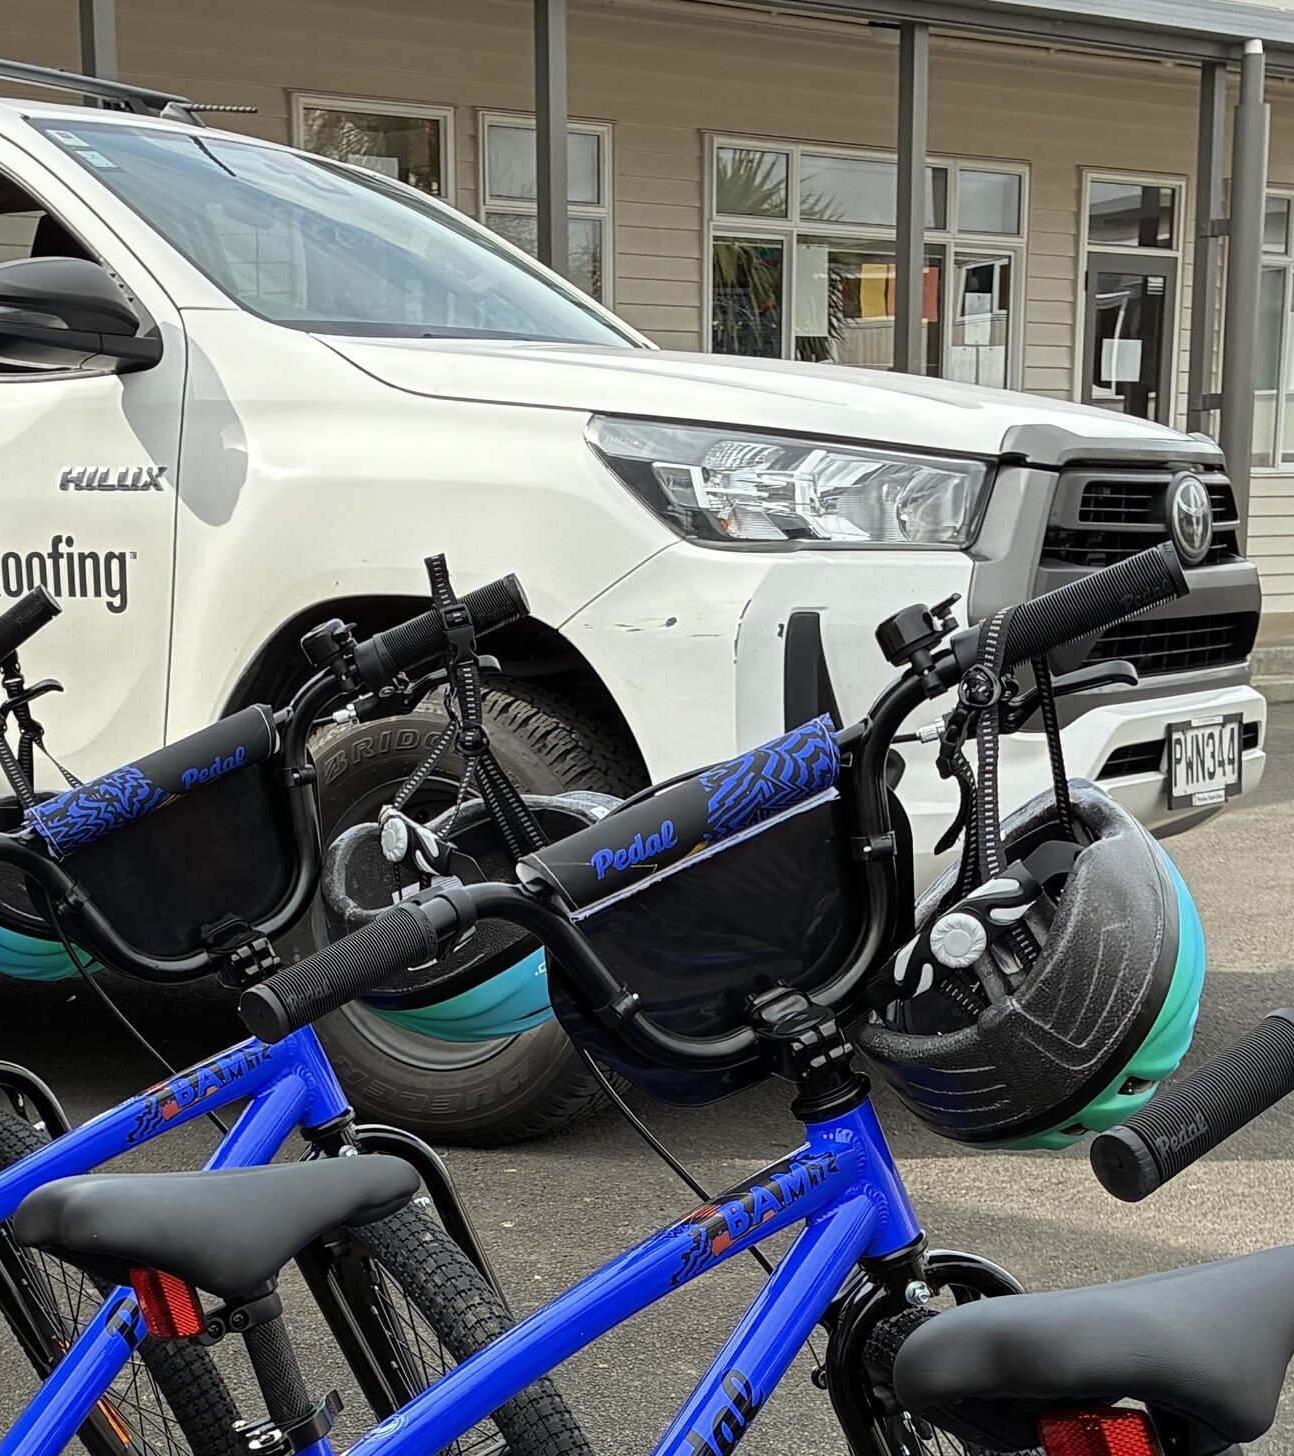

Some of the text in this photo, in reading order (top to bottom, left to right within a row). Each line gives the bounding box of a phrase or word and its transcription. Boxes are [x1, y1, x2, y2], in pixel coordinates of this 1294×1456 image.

[59, 466, 167, 491] HILUX
[182, 746, 246, 790] Pedal
[1174, 727, 1236, 788] PWN344
[591, 820, 678, 880] Pedal
[1156, 1111, 1209, 1160] Pedal
